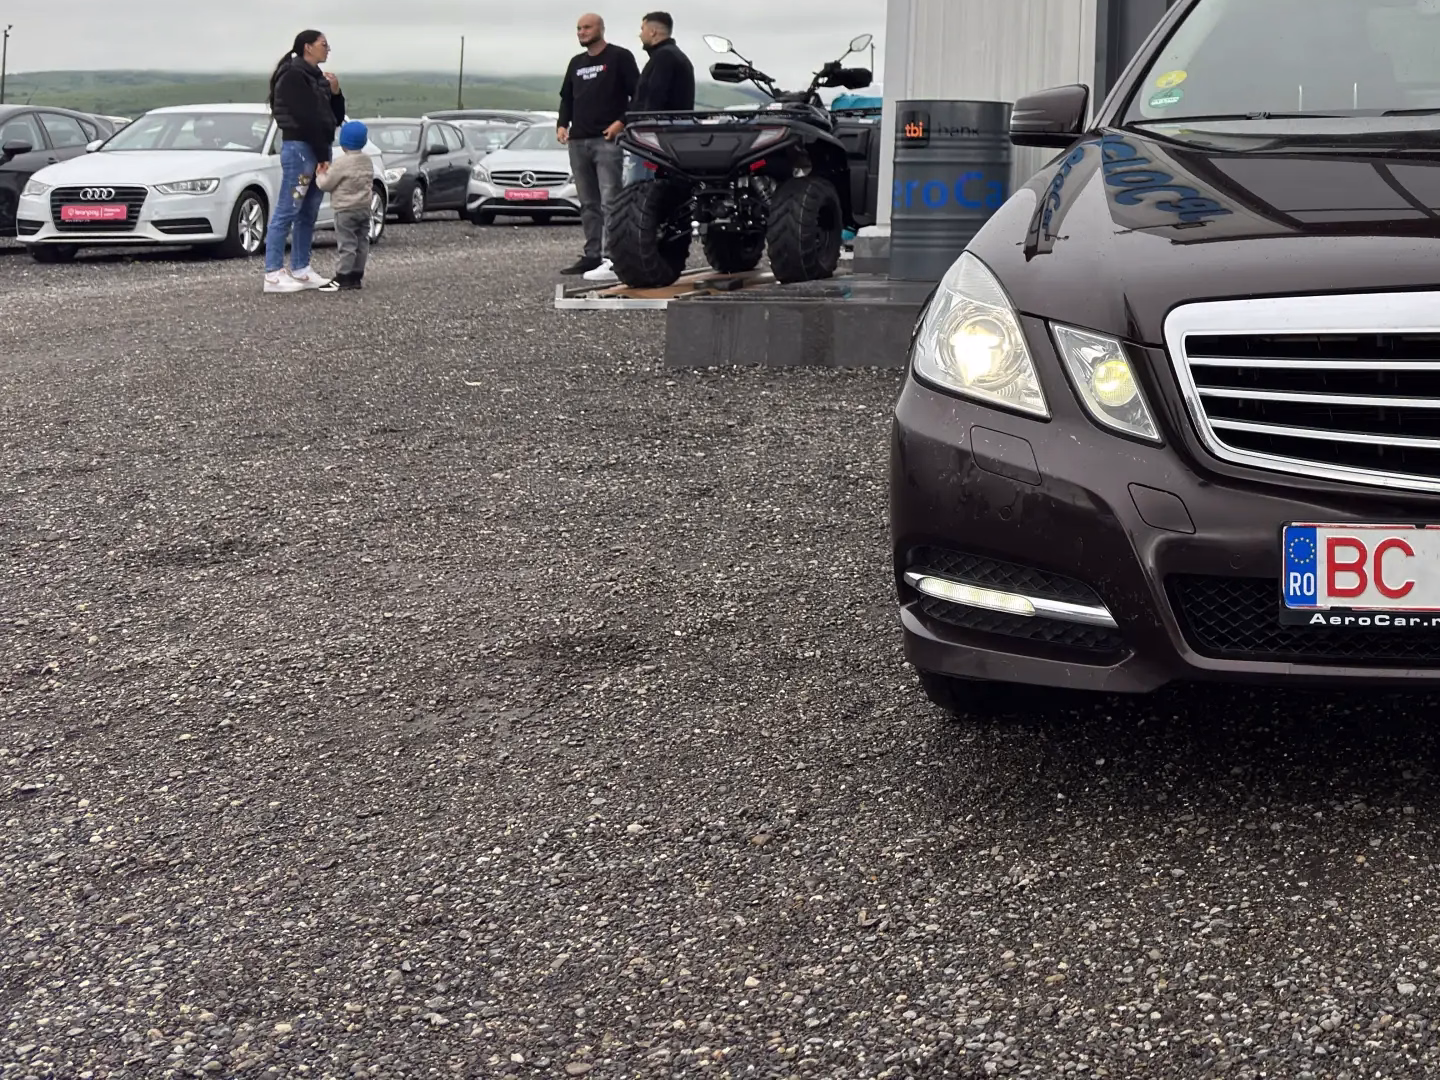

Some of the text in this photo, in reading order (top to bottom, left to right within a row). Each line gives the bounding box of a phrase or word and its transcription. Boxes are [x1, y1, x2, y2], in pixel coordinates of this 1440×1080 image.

[905, 122, 924, 138] tbi
[1326, 536, 1415, 598] BC
[1289, 572, 1315, 596] RO
